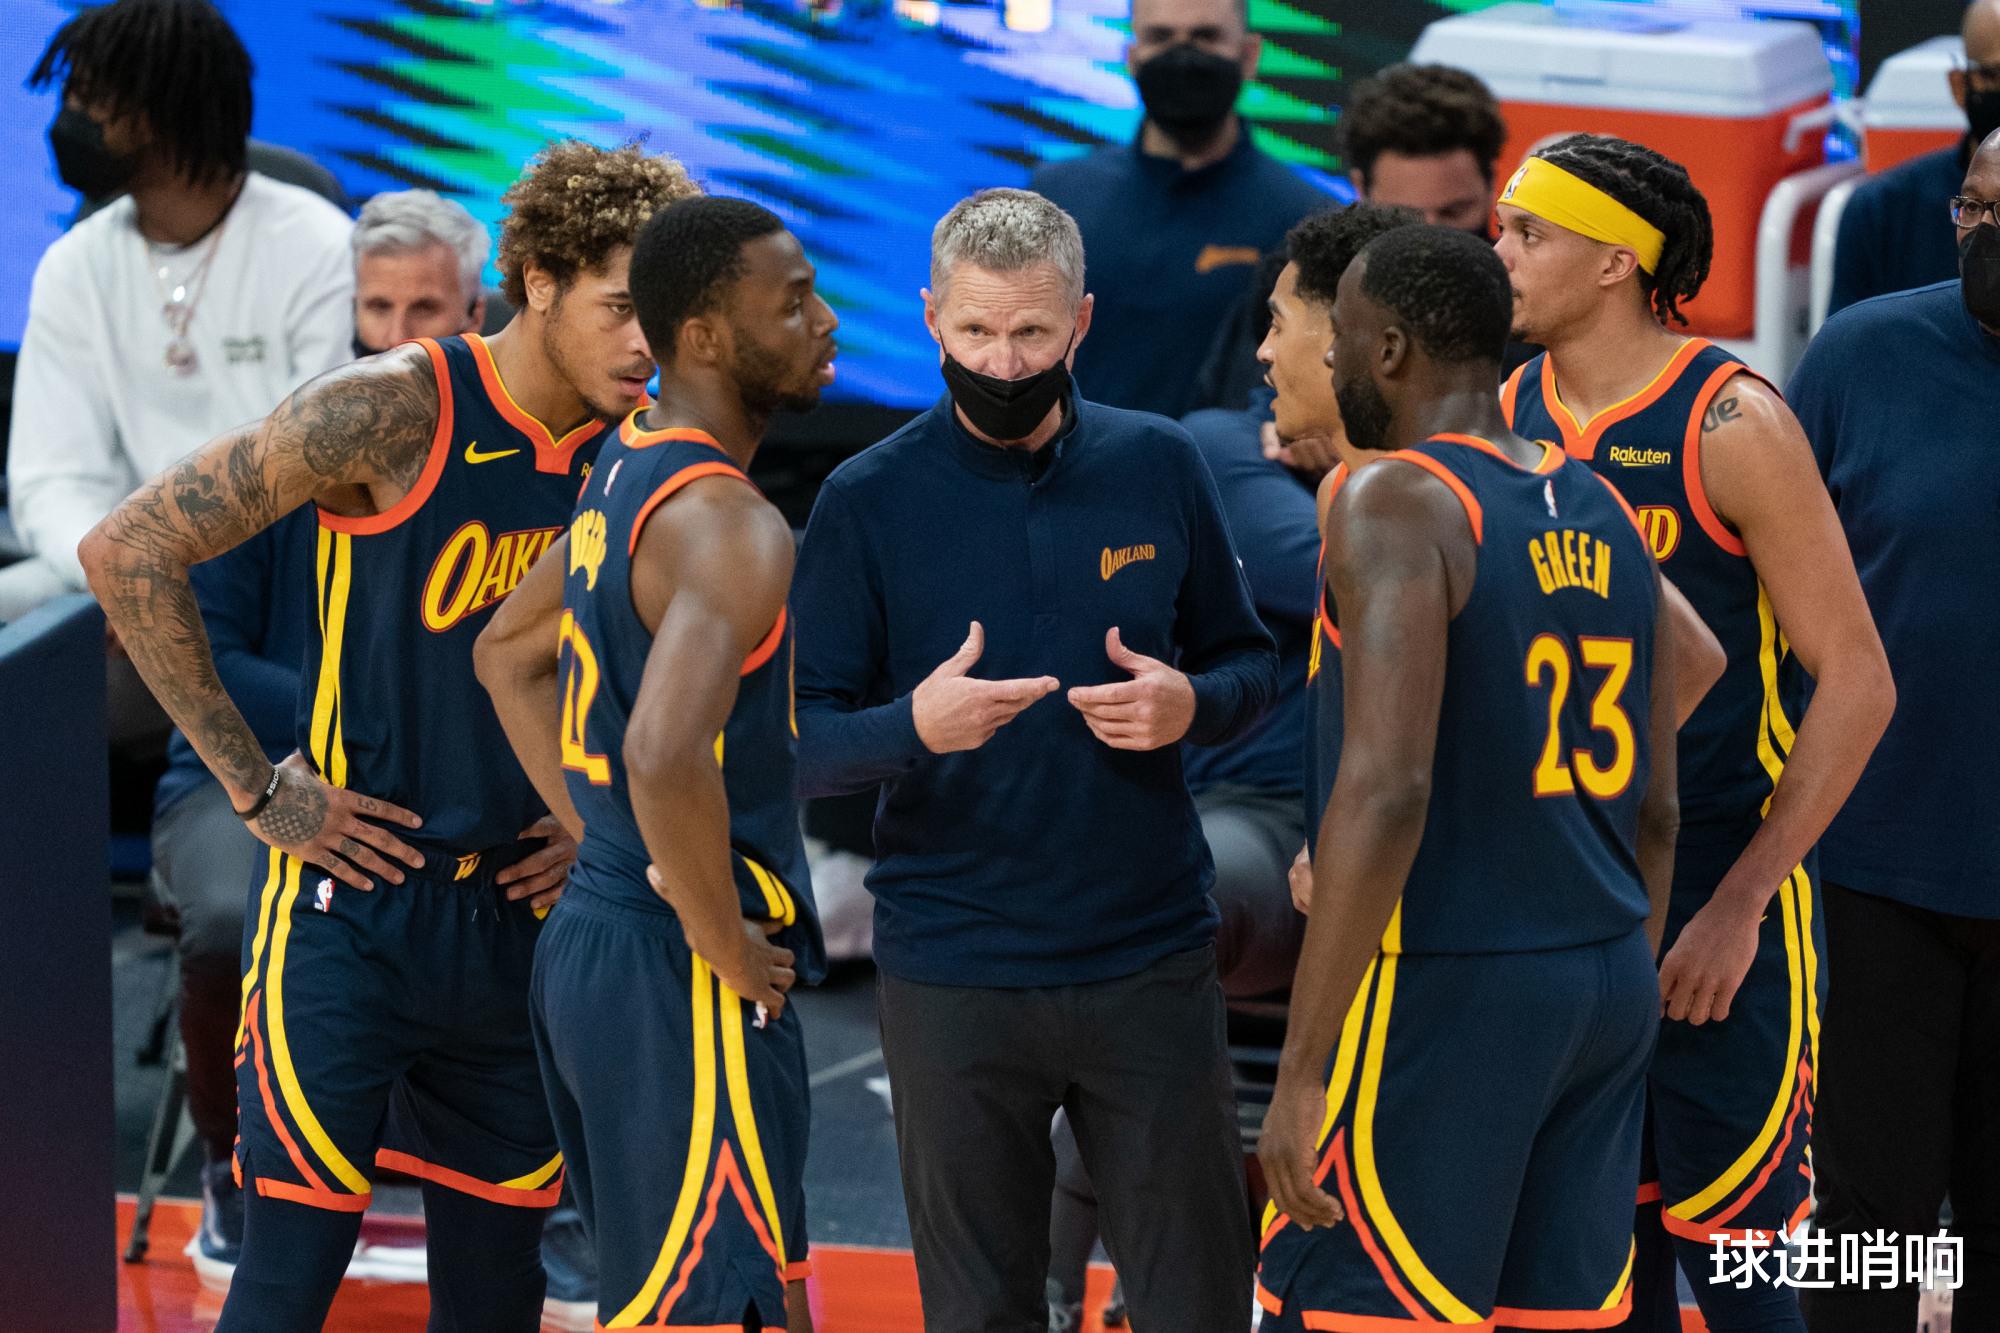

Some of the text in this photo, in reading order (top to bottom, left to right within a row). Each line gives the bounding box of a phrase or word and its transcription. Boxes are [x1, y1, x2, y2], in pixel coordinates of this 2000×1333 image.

[1610, 446, 1671, 465] Rakuten
[1100, 543, 1156, 581] OAKLAND
[1528, 529, 1612, 600] GREEN
[1525, 632, 1637, 800] 23
